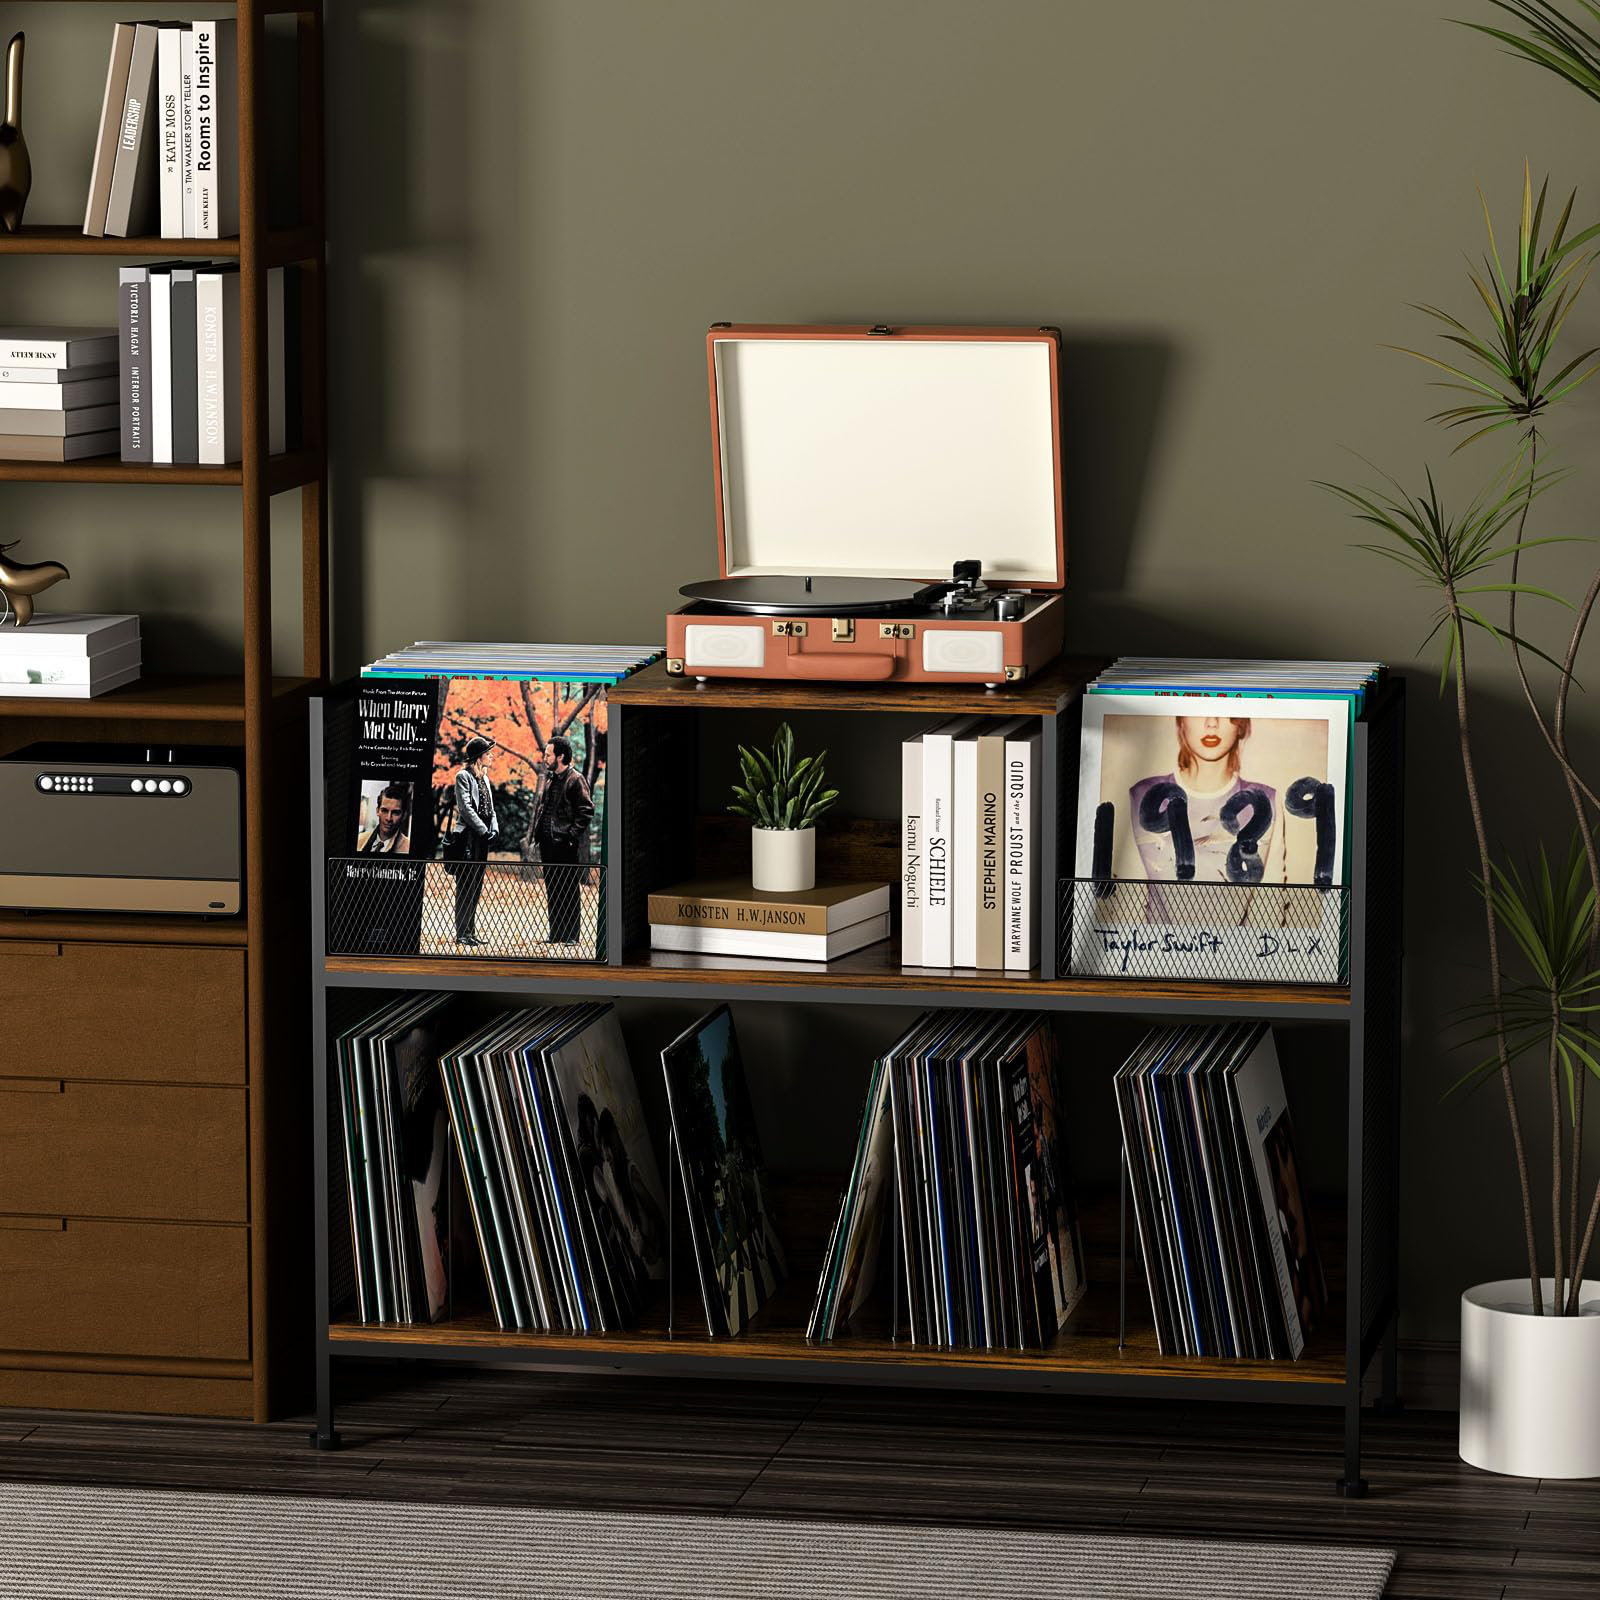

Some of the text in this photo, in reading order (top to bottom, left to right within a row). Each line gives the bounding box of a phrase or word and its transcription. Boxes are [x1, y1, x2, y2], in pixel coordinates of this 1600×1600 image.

[195, 33, 214, 88] Inspire
[183, 74, 191, 102] TELLER
[197, 94, 210, 111] to
[122, 98, 141, 151] LEADERSHIP
[165, 95, 176, 162] KATE MOSS
[184, 104, 192, 131] STORY
[184, 133, 192, 168] WALKER
[197, 116, 211, 171] Rooms
[204, 305, 217, 362] KONSTEN
[129, 284, 141, 449] VICTORIA HAGAN INTERIOR PORTRAITS
[358, 699, 430, 724] When Harry
[363, 720, 427, 745] Met Sally...
[1010, 760, 1024, 799] SQUID
[983, 792, 997, 910] STEPHEN MARINO
[1010, 826, 1023, 874] PROUST
[1092, 776, 1336, 898] 1989
[904, 815, 920, 908] Isamu Noguchi
[929, 837, 946, 906] SCHIELE
[677, 903, 729, 921] KONSTEN
[1012, 881, 1021, 905] WOLF
[1011, 906, 1021, 953] MARYANNE
[1094, 929, 1159, 972] Taylor
[1161, 931, 1223, 954] Swift
